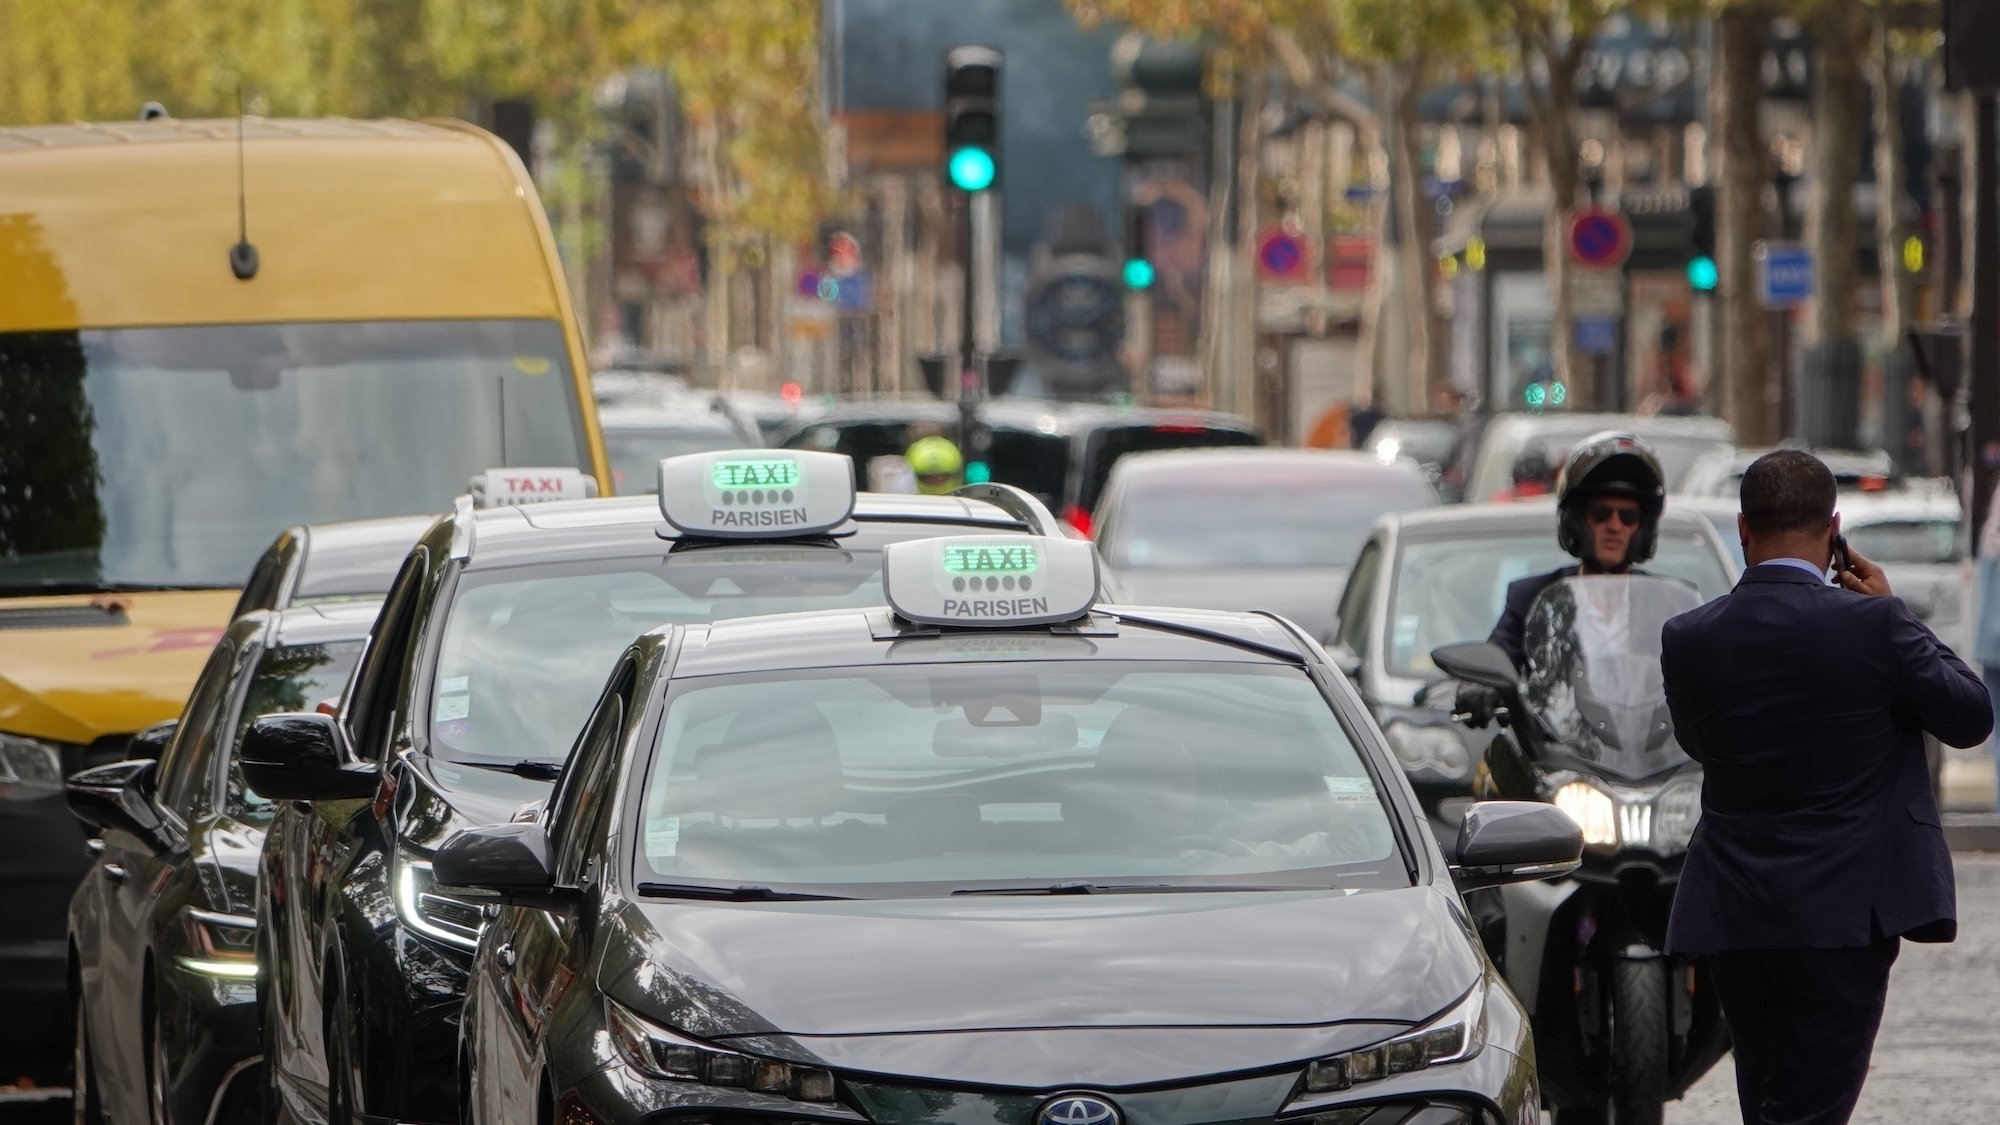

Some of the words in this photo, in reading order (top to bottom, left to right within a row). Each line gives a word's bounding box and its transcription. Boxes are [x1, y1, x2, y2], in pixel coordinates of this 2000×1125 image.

[726, 464, 790, 485] TAXI
[505, 478, 563, 493] TAXI
[711, 507, 808, 527] PARISIEN
[956, 548, 1029, 571] TAXI
[943, 597, 1049, 617] PARISIEN
